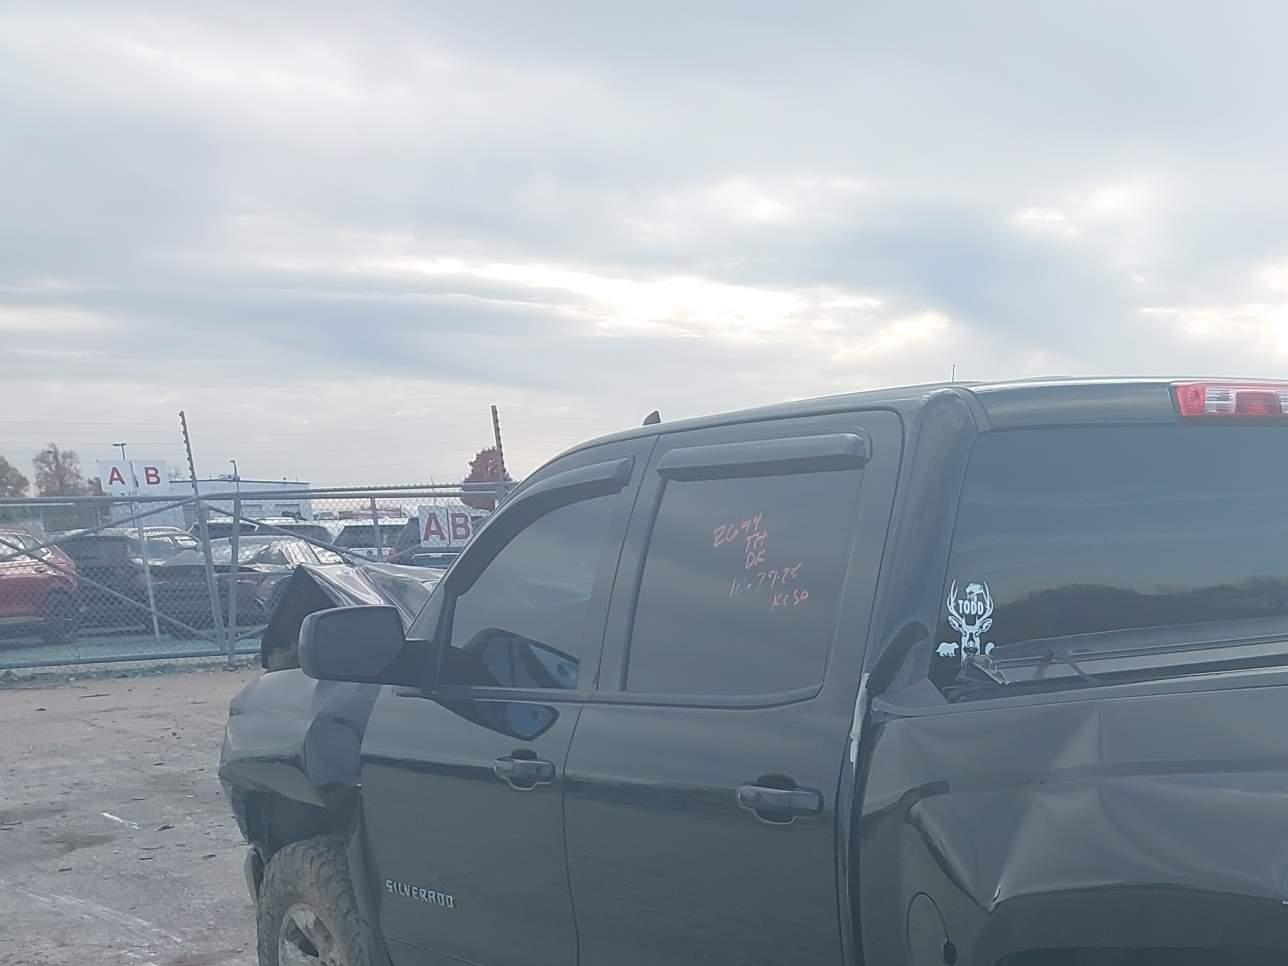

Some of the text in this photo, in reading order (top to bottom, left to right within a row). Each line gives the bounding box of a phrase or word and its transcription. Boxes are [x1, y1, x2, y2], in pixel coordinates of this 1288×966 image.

[108, 466, 161, 486] A B
[423, 512, 471, 541] A B
[958, 599, 985, 615] TODD
[385, 879, 455, 909] SILVERADO
